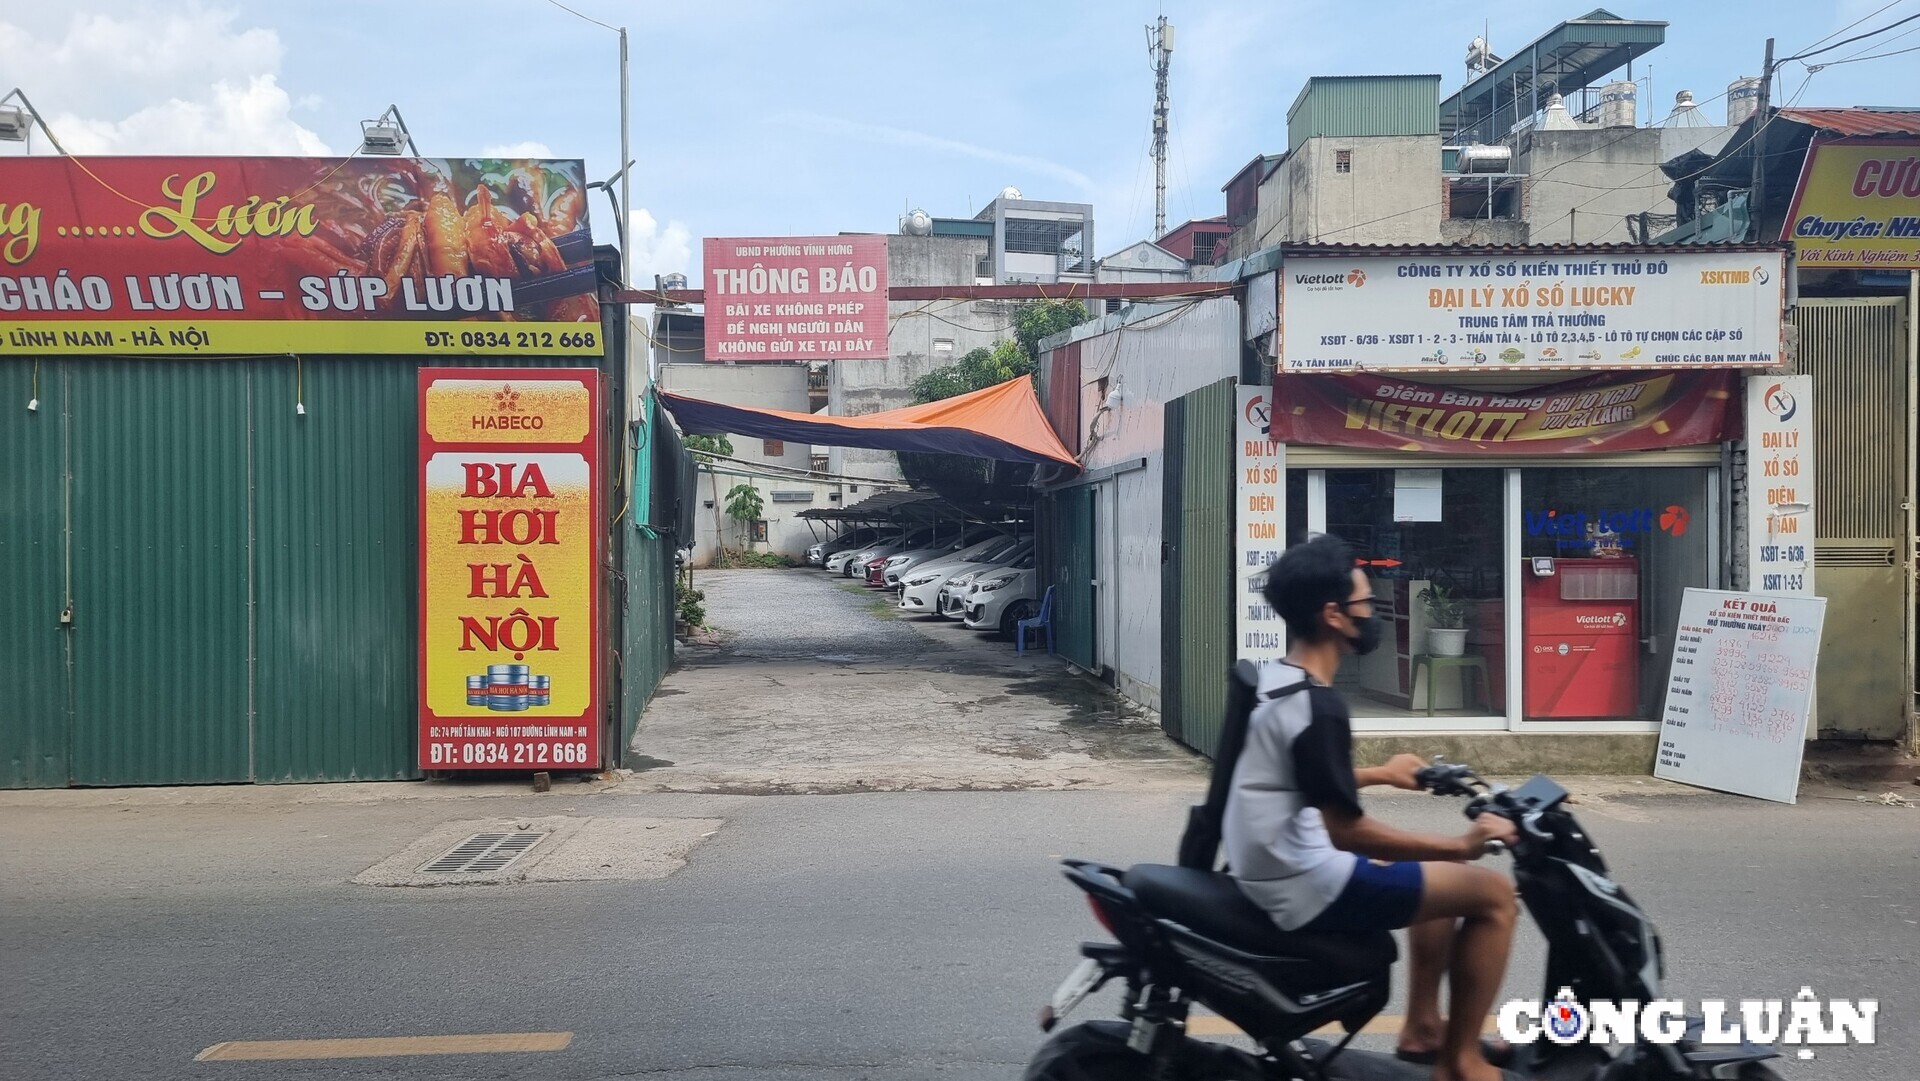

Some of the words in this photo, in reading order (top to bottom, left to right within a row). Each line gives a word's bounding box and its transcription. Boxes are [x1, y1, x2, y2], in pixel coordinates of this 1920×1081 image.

[139, 171, 318, 255] Lươn
[1796, 215, 1883, 241] Chuyên:
[736, 246, 761, 257] UBND
[763, 244, 801, 257] PHƯỜNG
[803, 245, 825, 256] VĨNH
[828, 244, 853, 256] HƯNG
[1800, 249, 1822, 261] Với
[1823, 250, 1854, 262] Kinh
[1857, 249, 1909, 264] Nghiệm
[1398, 263, 1441, 277] CÔNG
[1446, 265, 1464, 277] TY
[1469, 260, 1491, 277] XỔ
[1495, 260, 1517, 276] SỐ
[1521, 260, 1559, 276] KIẾN
[1564, 259, 1607, 275] THIẾT
[1612, 259, 1641, 275] THỦ
[1647, 260, 1668, 275] ĐÔ
[712, 263, 809, 294] THÔNG
[819, 262, 877, 293] BÁO
[1295, 272, 1345, 285] Vietlott
[1701, 271, 1750, 285] XSKTMB
[0, 269, 113, 311] CHÁO
[125, 273, 243, 311] LƯƠN
[299, 269, 388, 312] SÚP
[402, 274, 515, 312] LƯƠN
[1429, 288, 1463, 312] ĐẠI
[1471, 284, 1495, 308] LÝ
[1501, 280, 1530, 308] XỔ
[1536, 281, 1564, 307] SỐ
[1571, 286, 1636, 306] LUCKY
[726, 303, 749, 316] BÃI
[753, 304, 771, 316] XE
[776, 302, 824, 316] KHÔNG
[828, 301, 864, 315] PHÉP
[750, 322, 783, 337] NGHỊ
[787, 320, 830, 334] NGƯỜI
[834, 319, 864, 333] DÂN
[1459, 316, 1498, 328] TRUNG
[1502, 313, 1527, 328] TÂM
[1532, 311, 1554, 327] TRẢ
[1558, 311, 1606, 327] THƯỞNG
[9, 328, 57, 347] LĨNH
[63, 331, 114, 346] NAM
[131, 326, 163, 346] HÀ
[169, 326, 210, 350] NỘI
[425, 331, 454, 348] ĐT:
[461, 331, 511, 348] 0834
[517, 332, 553, 348] 212
[559, 332, 596, 348] 668
[1320, 335, 1346, 345] XSĐT
[1356, 335, 1379, 345] 6/36
[1388, 334, 1415, 344] XSĐT
[1418, 334, 1423, 344] 1
[1433, 334, 1440, 344] 2
[1450, 333, 1457, 343] 3
[1496, 331, 1511, 343] TÀI
[1514, 333, 1521, 343] 4
[1531, 331, 1541, 343] LÔ
[1546, 331, 1558, 343] TÔ
[1561, 332, 1595, 344] 2,3,4,5
[1605, 330, 1617, 341] LÔ
[1620, 330, 1633, 341] TÔ
[1651, 330, 1679, 343] CHỌN
[1682, 329, 1702, 341] CÁC
[1705, 329, 1726, 343] CẶP
[1729, 327, 1743, 340] SỐ
[718, 339, 766, 353] KHÔNG
[770, 338, 794, 353] GỬI
[798, 340, 815, 352] XE
[819, 339, 841, 354] TẠI
[845, 338, 873, 352] ĐÂY
[1290, 360, 1302, 368] 74
[1306, 359, 1326, 368] TÂN
[1655, 352, 1680, 363] CHÚC
[1683, 352, 1701, 363] CÁC
[1704, 353, 1724, 364] BẠN
[1727, 353, 1746, 362] MAY
[1749, 351, 1771, 362] MẮN
[1575, 391, 1601, 412] 10
[472, 415, 544, 429] HABECO
[1344, 397, 1527, 442] VIETLOTT
[1539, 414, 1572, 430] VUI
[1762, 431, 1782, 452] ĐẠI
[1785, 428, 1799, 448] LÝ
[1245, 441, 1263, 460] ĐẠI
[1246, 462, 1261, 484] XỔ
[1263, 462, 1278, 484] SỐ
[1764, 454, 1779, 477] XỔ
[1783, 454, 1799, 477] SỐ
[461, 462, 555, 499] BIA
[1249, 492, 1274, 515] ĐIỆN
[457, 507, 560, 546] HƠI
[1248, 520, 1276, 539] TOÁN
[1760, 545, 1779, 562] XSĐT
[1788, 544, 1804, 562] 6/36
[467, 553, 549, 599] HÀ
[1763, 574, 1781, 591] XSKT
[1784, 573, 1803, 590] 1-2-3
[1723, 597, 1747, 611] KẾT
[1750, 600, 1777, 613] QUẢ
[1576, 615, 1611, 624] Vietlott
[458, 607, 560, 661] NỘI
[442, 726, 450, 738] 74
[476, 726, 491, 738] KHAI
[559, 726, 573, 737] NAM
[578, 726, 587, 737] HN
[430, 743, 458, 763] ĐT:
[463, 743, 509, 763] 0834
[513, 743, 548, 763] 212
[553, 743, 587, 763] 668
